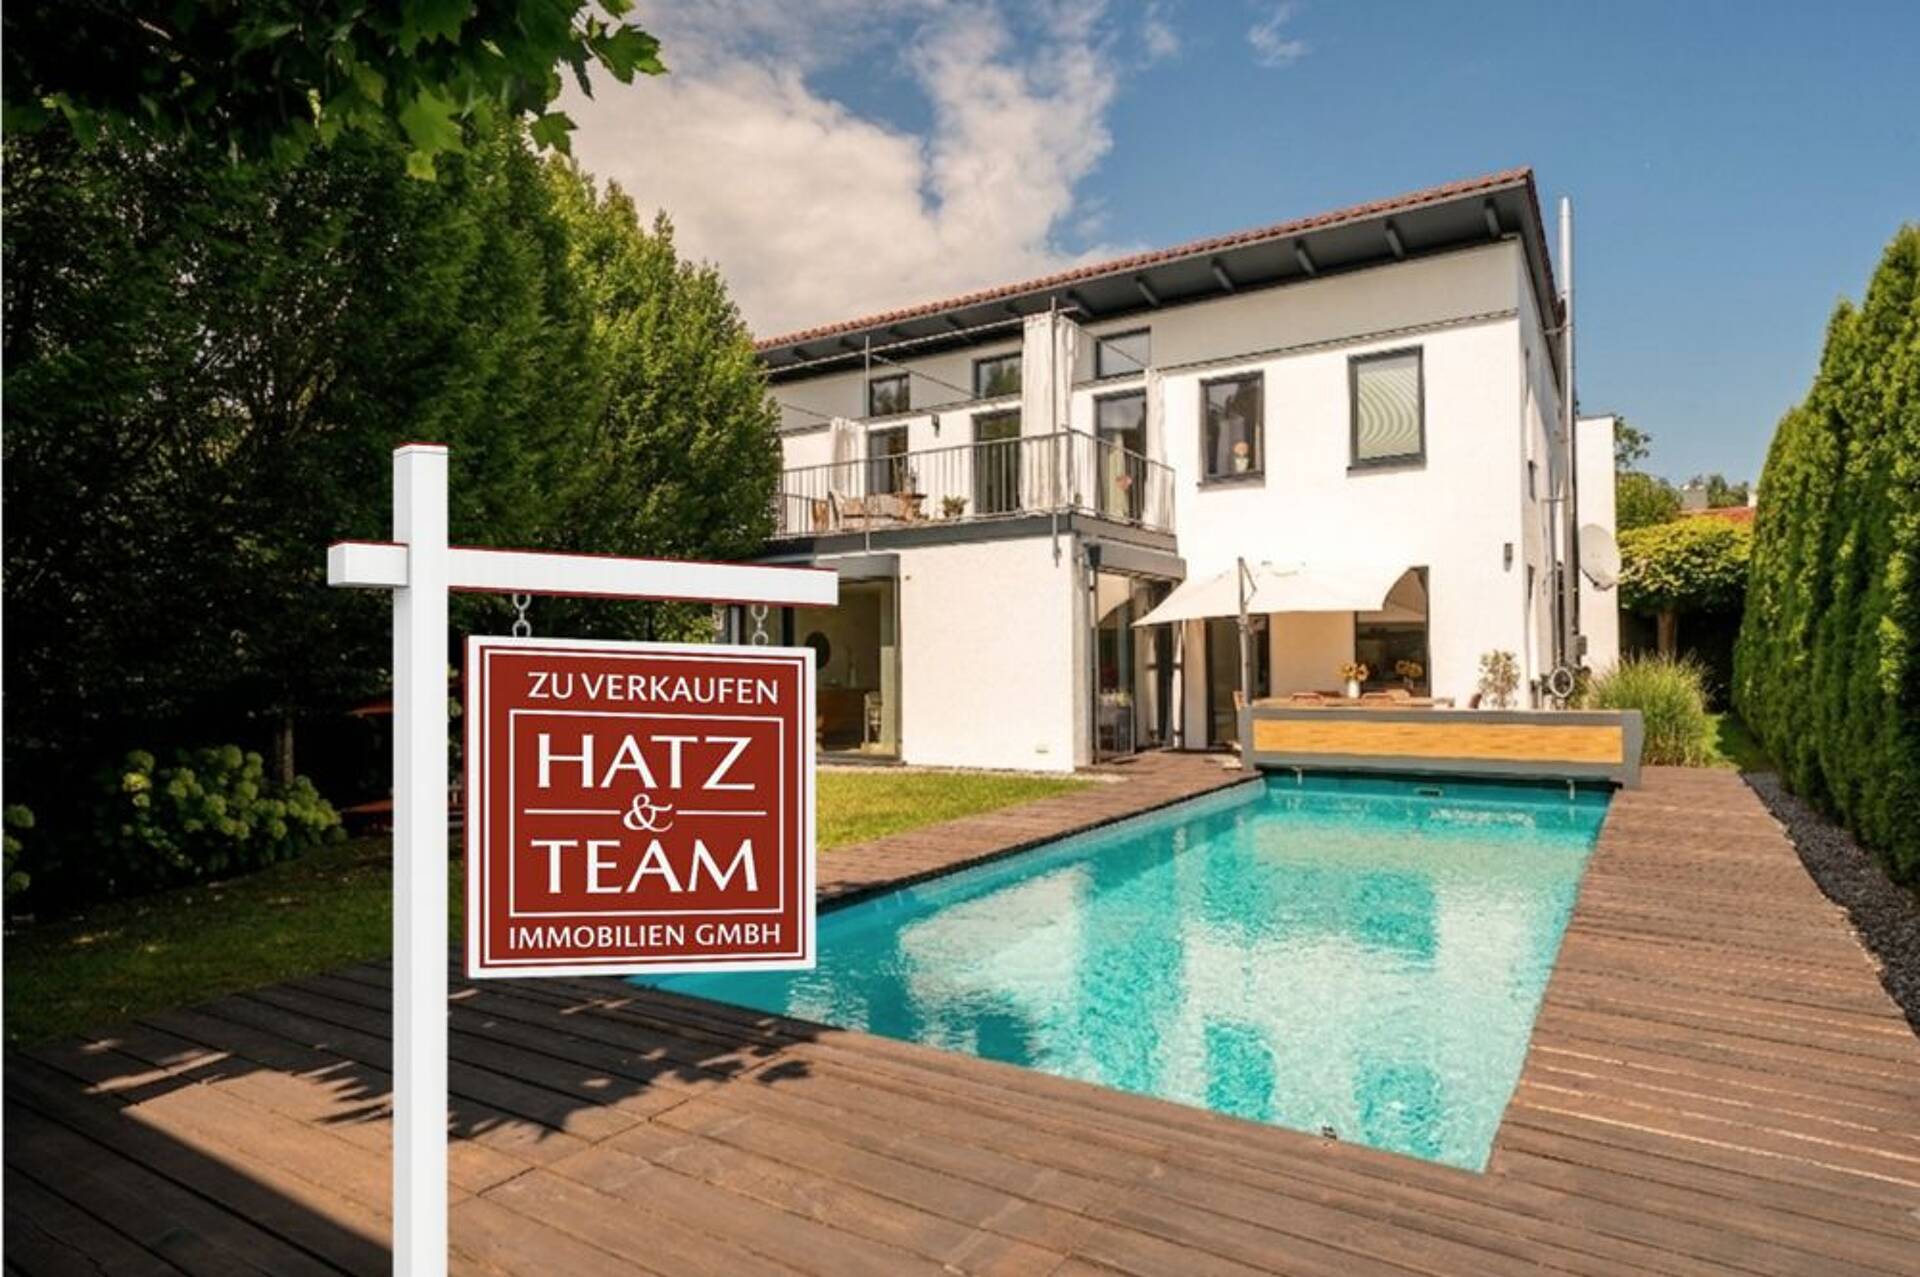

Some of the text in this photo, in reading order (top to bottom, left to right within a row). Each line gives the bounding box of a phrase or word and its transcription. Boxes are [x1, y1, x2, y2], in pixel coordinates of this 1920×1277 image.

[527, 671, 779, 705] ZU VERKAUFEN
[537, 732, 756, 791] HATZ
[622, 792, 674, 833] &
[529, 838, 759, 895] TEAM
[508, 922, 782, 950] IMMOBILIEN GMBH
